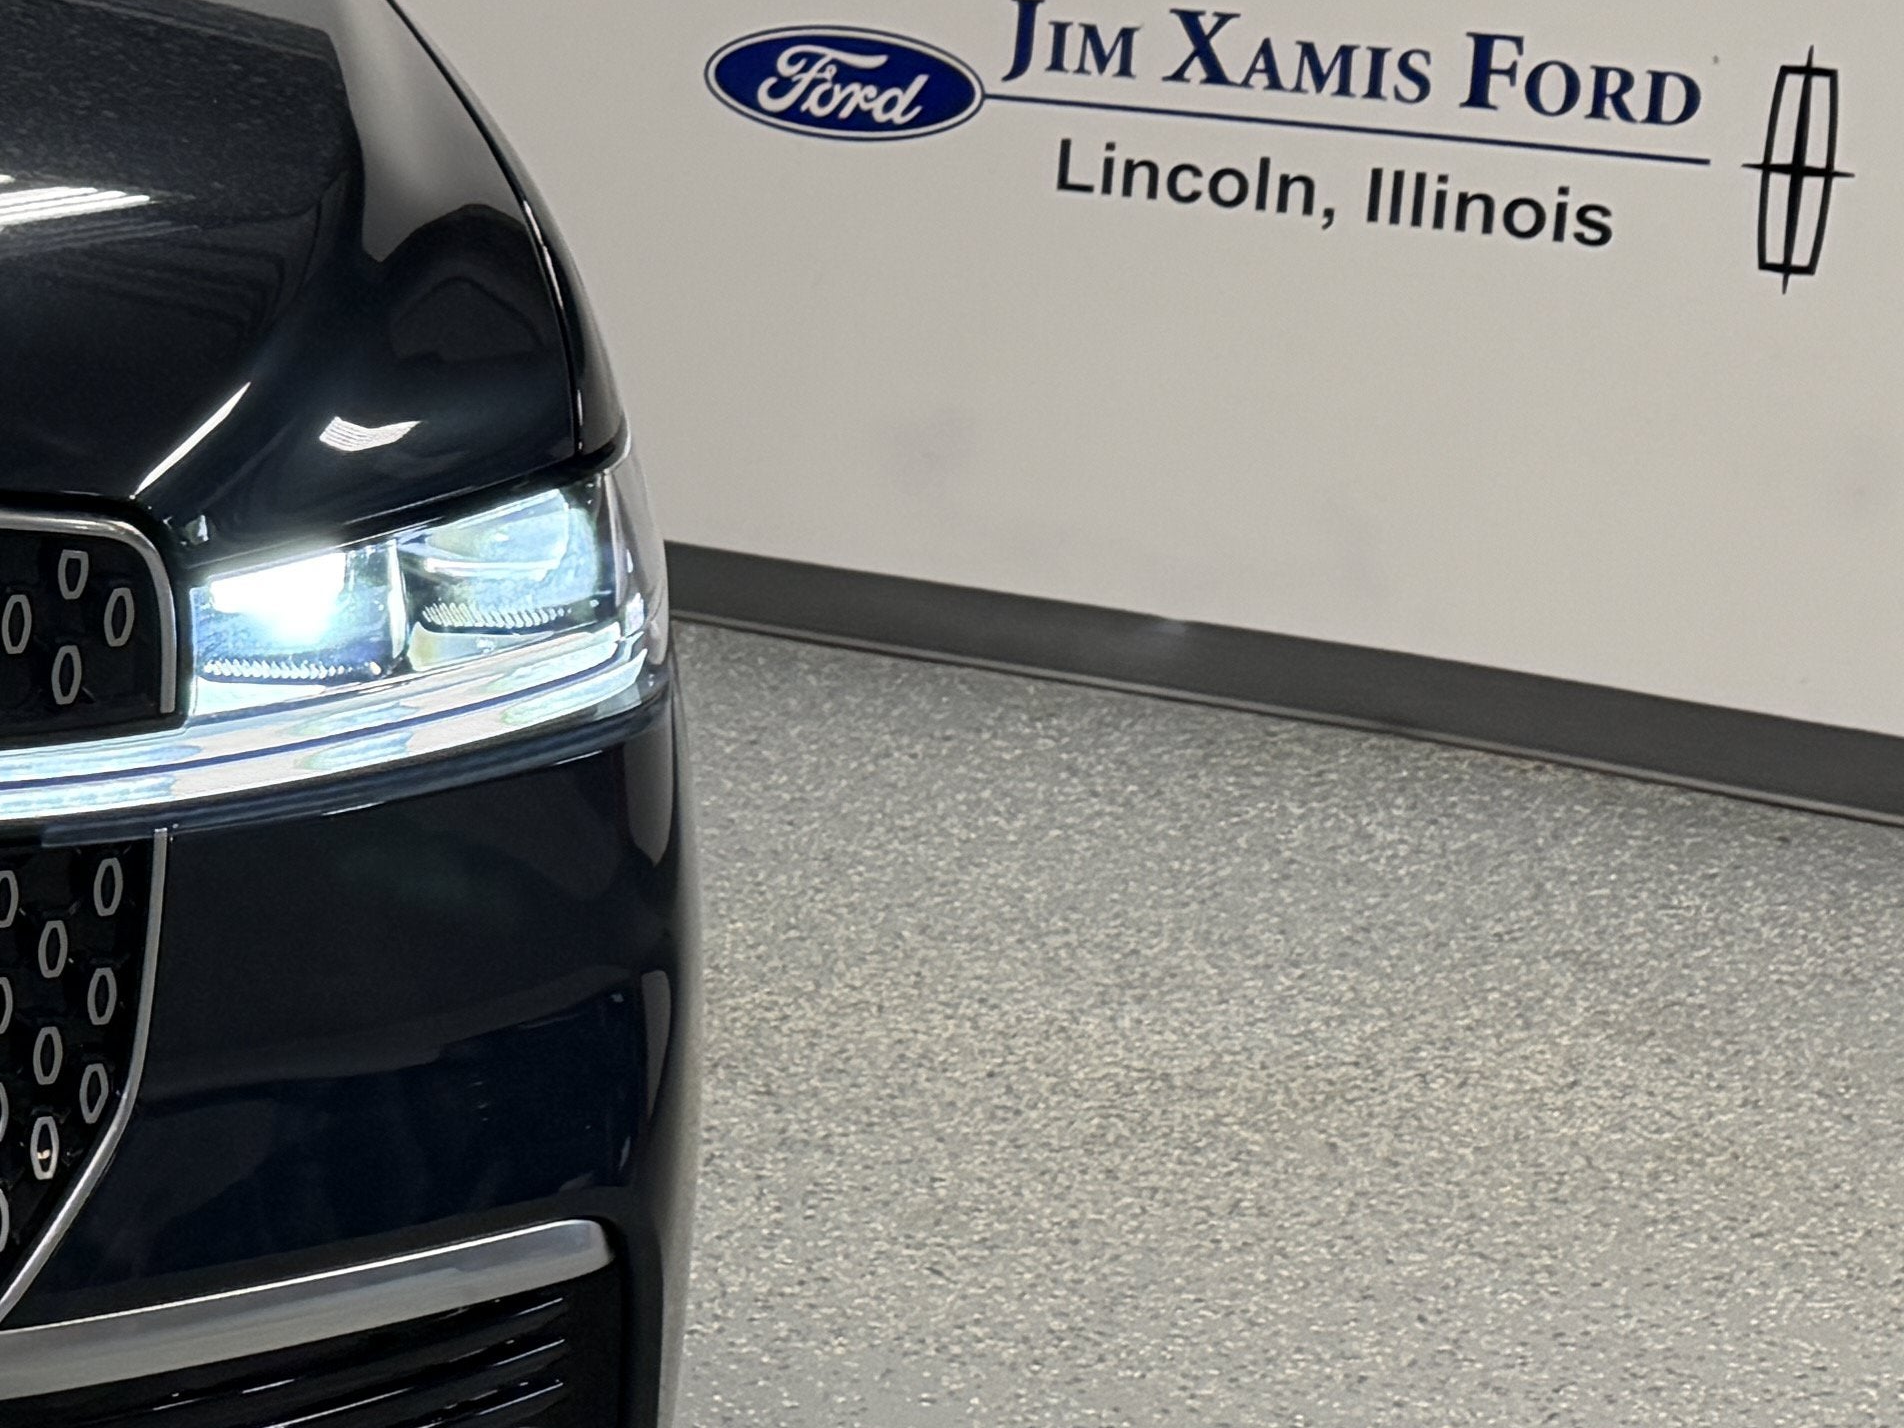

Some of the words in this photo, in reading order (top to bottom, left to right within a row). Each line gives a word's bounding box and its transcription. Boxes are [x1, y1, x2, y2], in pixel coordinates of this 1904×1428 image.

[758, 44, 923, 126] Ford
[1163, 7, 1432, 105] XAMIS
[1459, 31, 1703, 127] FORD
[1055, 138, 1337, 231] Lincoln,
[1365, 168, 1614, 248] Illinois
